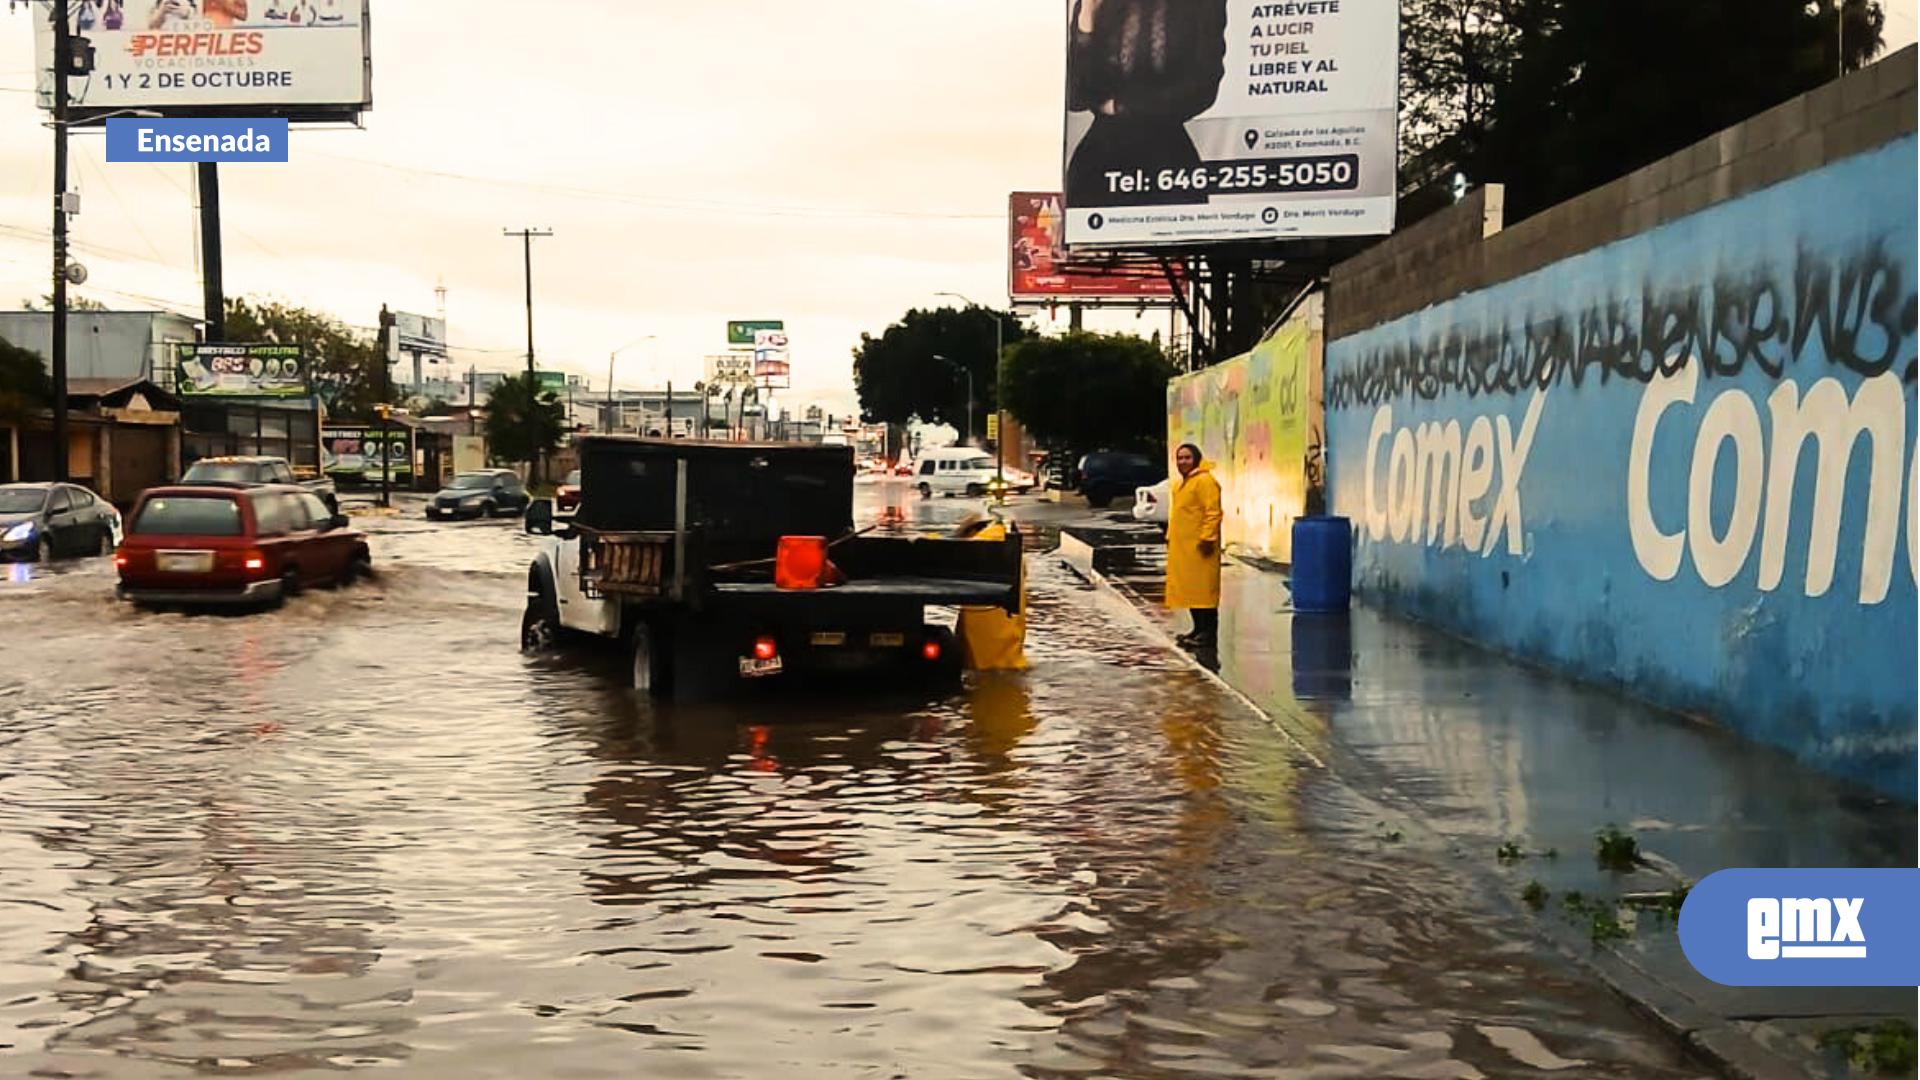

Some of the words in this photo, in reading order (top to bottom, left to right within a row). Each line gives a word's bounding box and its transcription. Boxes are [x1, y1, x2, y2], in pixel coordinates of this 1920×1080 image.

[173, 20, 213, 31] EXPO
[1251, 24, 1263, 38] A
[1267, 22, 1314, 37] LUCIR
[131, 32, 263, 57] PERFILES
[1250, 44, 1271, 57] TU
[1274, 41, 1309, 56] PIEL
[134, 57, 255, 69] VOCACIONALES
[1250, 61, 1297, 77] LIBRE
[1301, 60, 1313, 74] Y
[1316, 59, 1339, 73] AL
[104, 74, 113, 89] 1
[119, 73, 132, 88] Y
[139, 73, 151, 88] 2
[158, 72, 185, 88] DE
[191, 70, 292, 88] OCTUBRE
[1248, 79, 1328, 96] NATURAL
[1104, 168, 1151, 193] Tel:
[1157, 160, 1352, 191] 646-255-5050
[1365, 385, 1549, 558] Comex
[1628, 353, 1917, 604] Com
